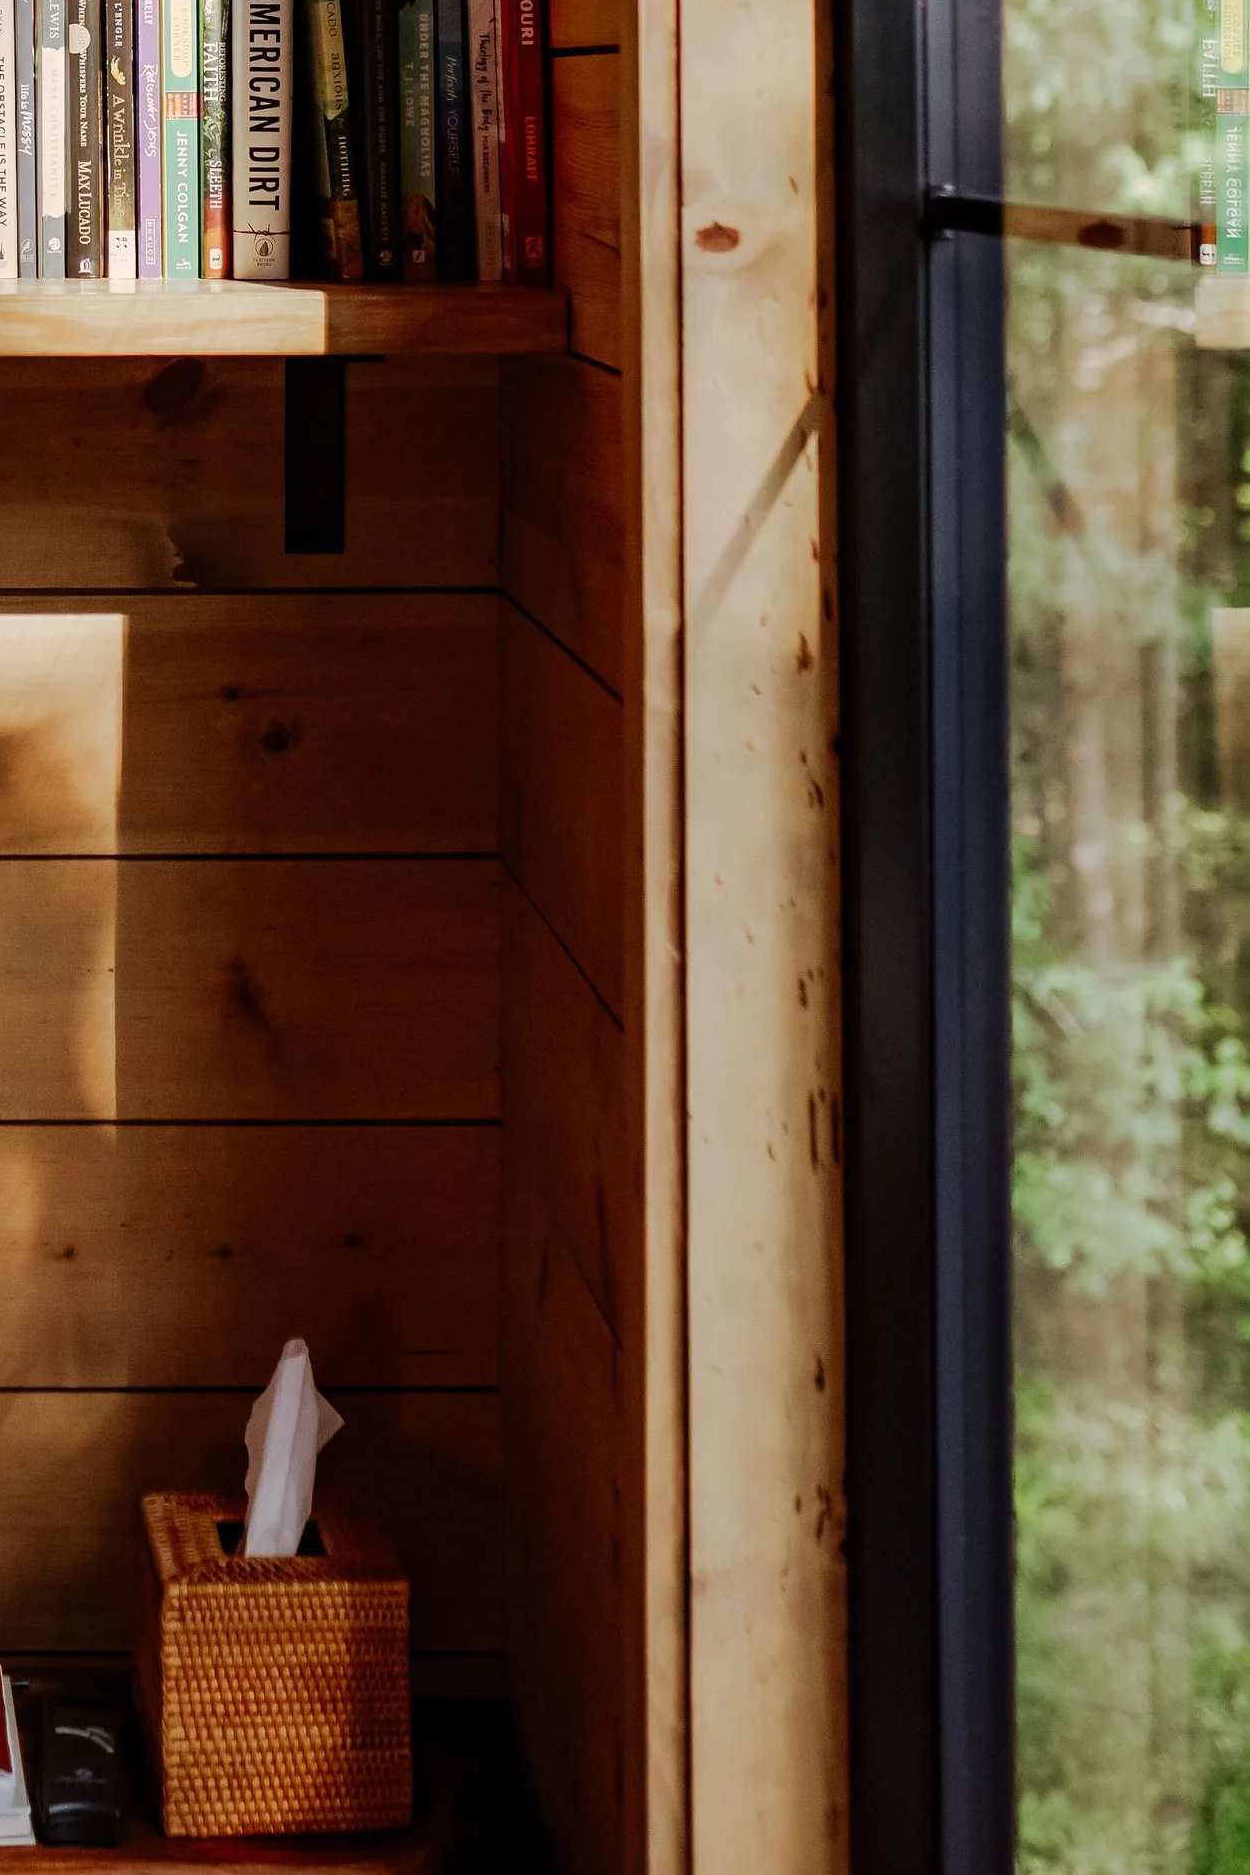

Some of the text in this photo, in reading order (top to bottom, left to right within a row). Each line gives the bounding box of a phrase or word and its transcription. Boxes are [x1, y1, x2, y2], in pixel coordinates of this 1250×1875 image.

[114, 2, 123, 47] L'ENGLE
[144, 0, 153, 25] KELLY
[181, 7, 190, 67] BOOKSHOP
[173, 17, 181, 61] CORNER
[20, 83, 30, 100] life
[79, 50, 88, 93] WHISPERS
[203, 41, 218, 102] FAITH
[218, 42, 227, 102] REFORESTING
[331, 53, 345, 110] anxious
[419, 13, 431, 177] UNDER THE MAGNOLIAS
[477, 33, 494, 131] Theology of the Body
[20, 101, 30, 110] is
[79, 94, 88, 121] YOUR
[112, 94, 123, 108] A
[140, 64, 158, 157] Rediscover Jesus
[405, 89, 415, 127] LOWE
[445, 56, 460, 175] Perfectly YOURSELF
[50, 68, 58, 198] MERE CHRISTIANITY
[80, 122, 88, 147] NAME
[112, 111, 130, 166] Wrinkle
[176, 129, 188, 178] JENNY
[524, 116, 538, 182] LOHRAFF
[113, 169, 125, 180] in
[209, 159, 223, 209] SLEETH
[248, 146, 281, 211] DIRT
[78, 160, 92, 245] MAX LUCADO
[176, 182, 189, 243] COLGAN
[146, 221, 154, 263] BEACON
